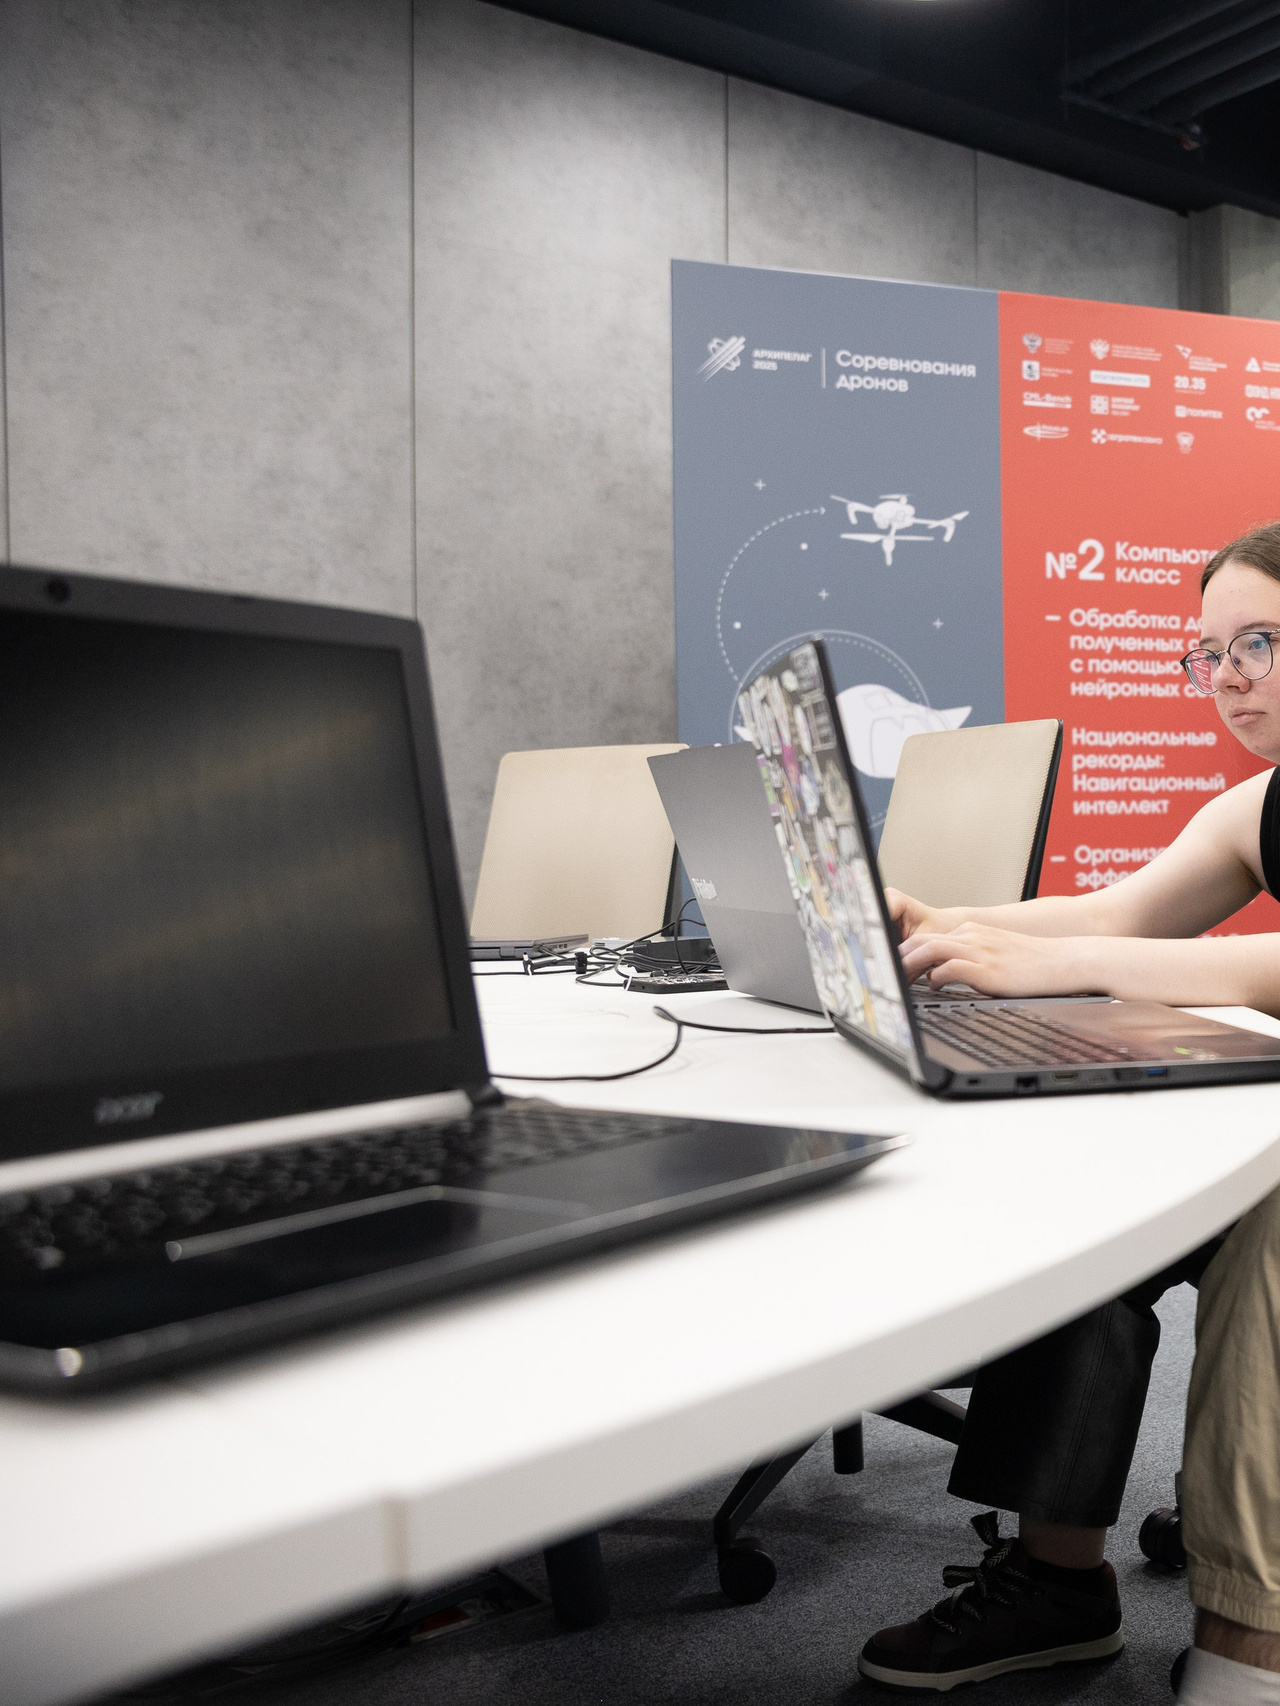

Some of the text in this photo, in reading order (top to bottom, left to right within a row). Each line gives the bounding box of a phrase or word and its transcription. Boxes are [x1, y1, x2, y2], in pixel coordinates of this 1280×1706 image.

[753, 349, 813, 363] АРХИПЕЛАГ
[835, 349, 977, 378] Соревнования
[753, 360, 778, 371] 2025
[836, 374, 909, 392] дронов
[1174, 375, 1206, 390] 20.35
[1115, 567, 1181, 585] класс
[1069, 608, 1181, 631] Обработка
[1070, 635, 1184, 654] полученных
[1070, 658, 1183, 676] с помощью
[1070, 678, 1180, 700] нейронных
[1071, 728, 1218, 748] Национальные
[1072, 753, 1165, 772] рекорды:
[1072, 773, 1226, 793] Навигационный
[1073, 799, 1169, 815] интеллект
